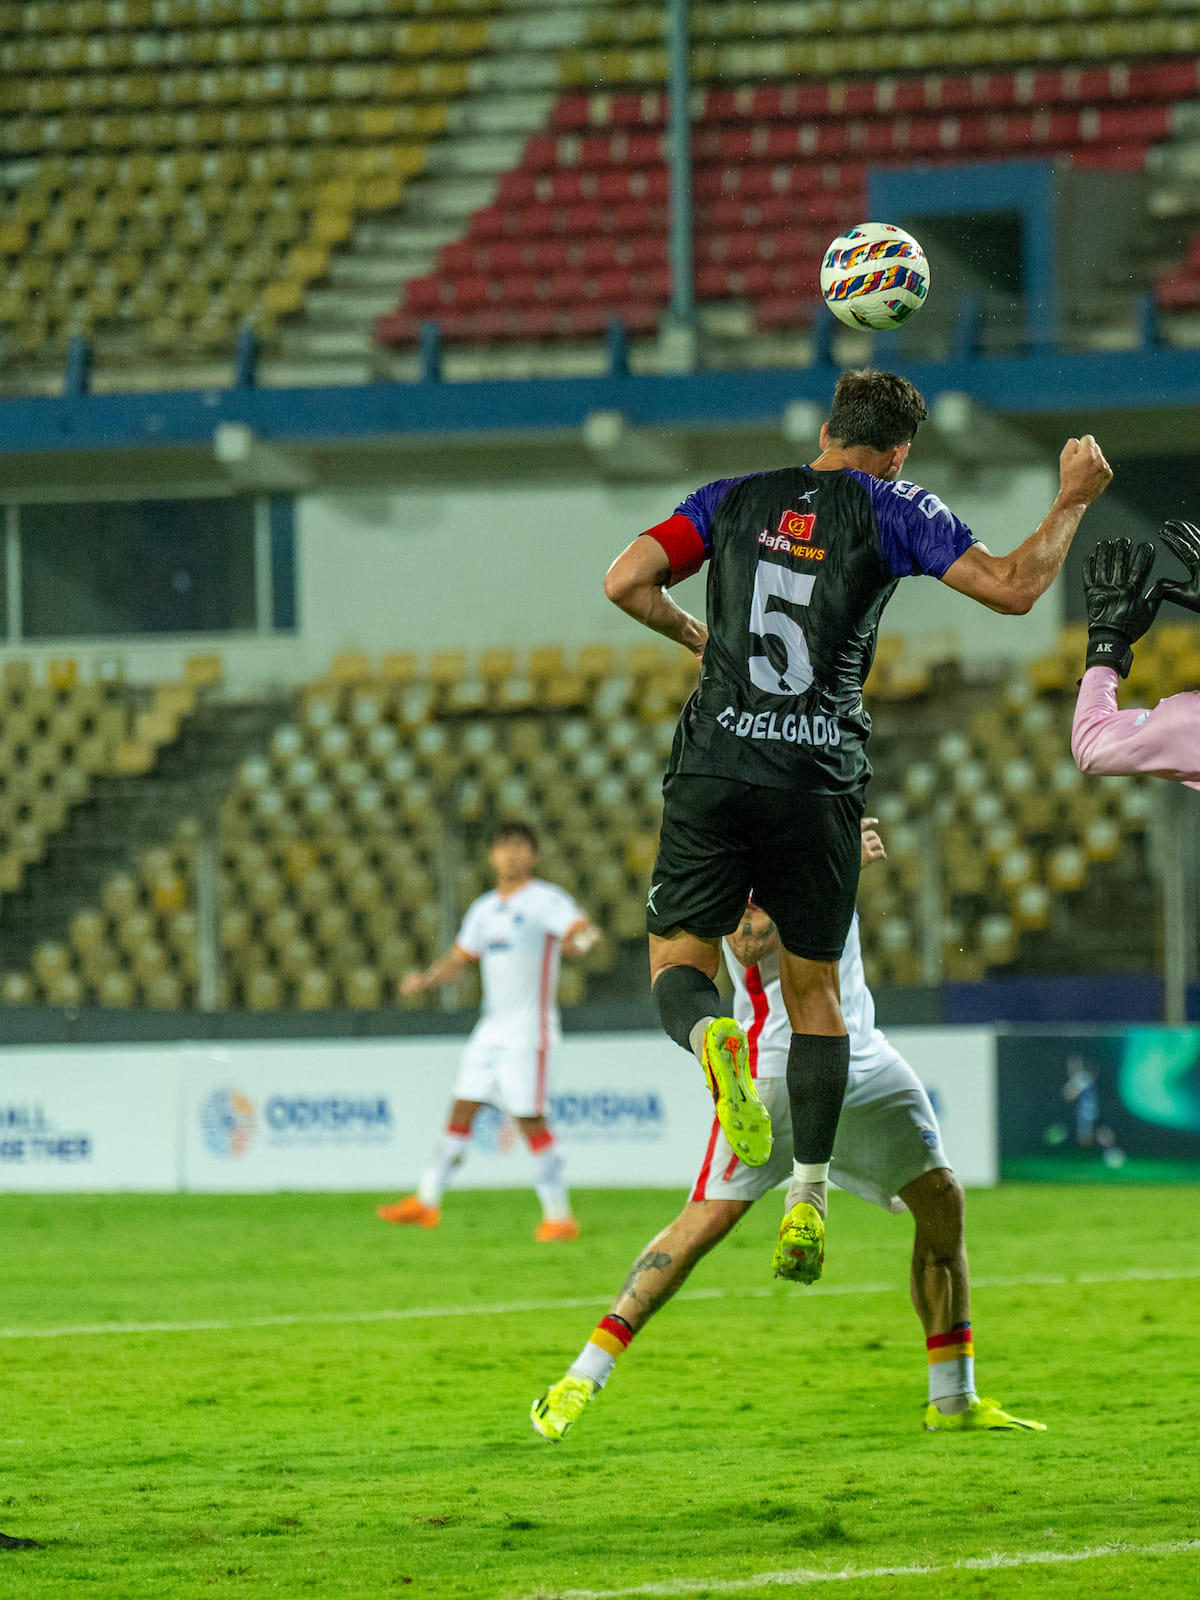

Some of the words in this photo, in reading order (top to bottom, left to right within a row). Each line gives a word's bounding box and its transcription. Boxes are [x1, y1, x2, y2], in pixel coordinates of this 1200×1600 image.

[748, 559, 817, 697] 5
[1095, 642, 1114, 653] AK
[264, 1092, 394, 1130] ODISHA
